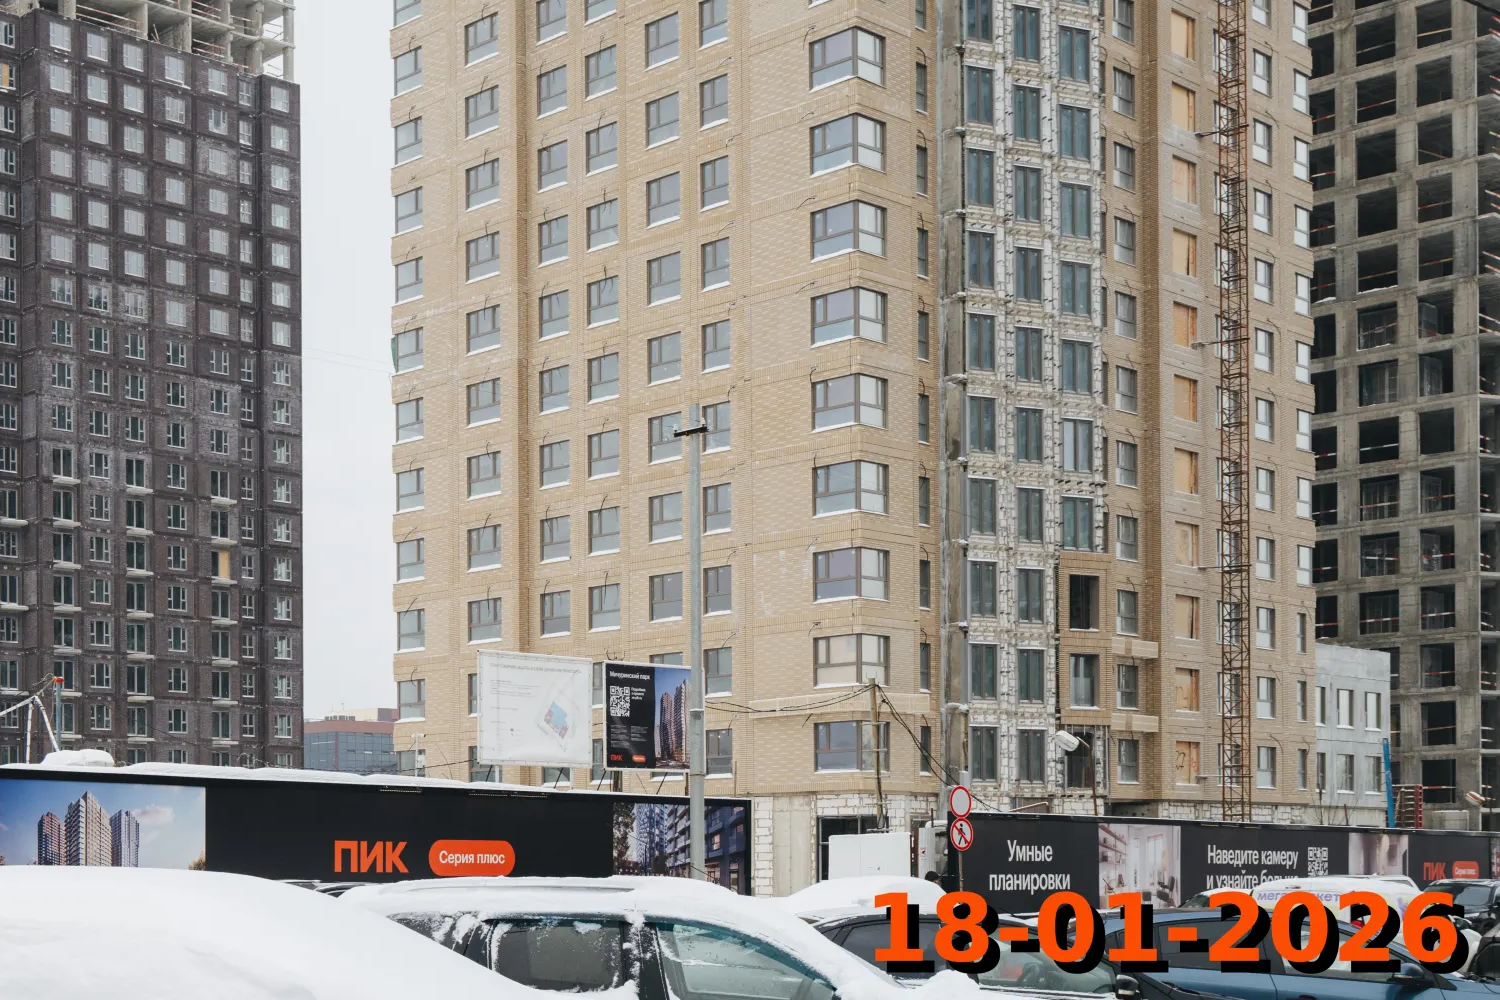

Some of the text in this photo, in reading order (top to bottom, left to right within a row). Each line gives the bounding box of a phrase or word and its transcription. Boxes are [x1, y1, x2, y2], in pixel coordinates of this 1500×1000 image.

[334, 840, 409, 873] ПИК
[439, 850, 506, 866] Серия плюс
[1007, 839, 1053, 862] Умные
[1207, 844, 1299, 869] Наведите камеру
[1423, 862, 1446, 880] ПИК
[989, 873, 1071, 895] планировки
[1206, 875, 1214, 890] и
